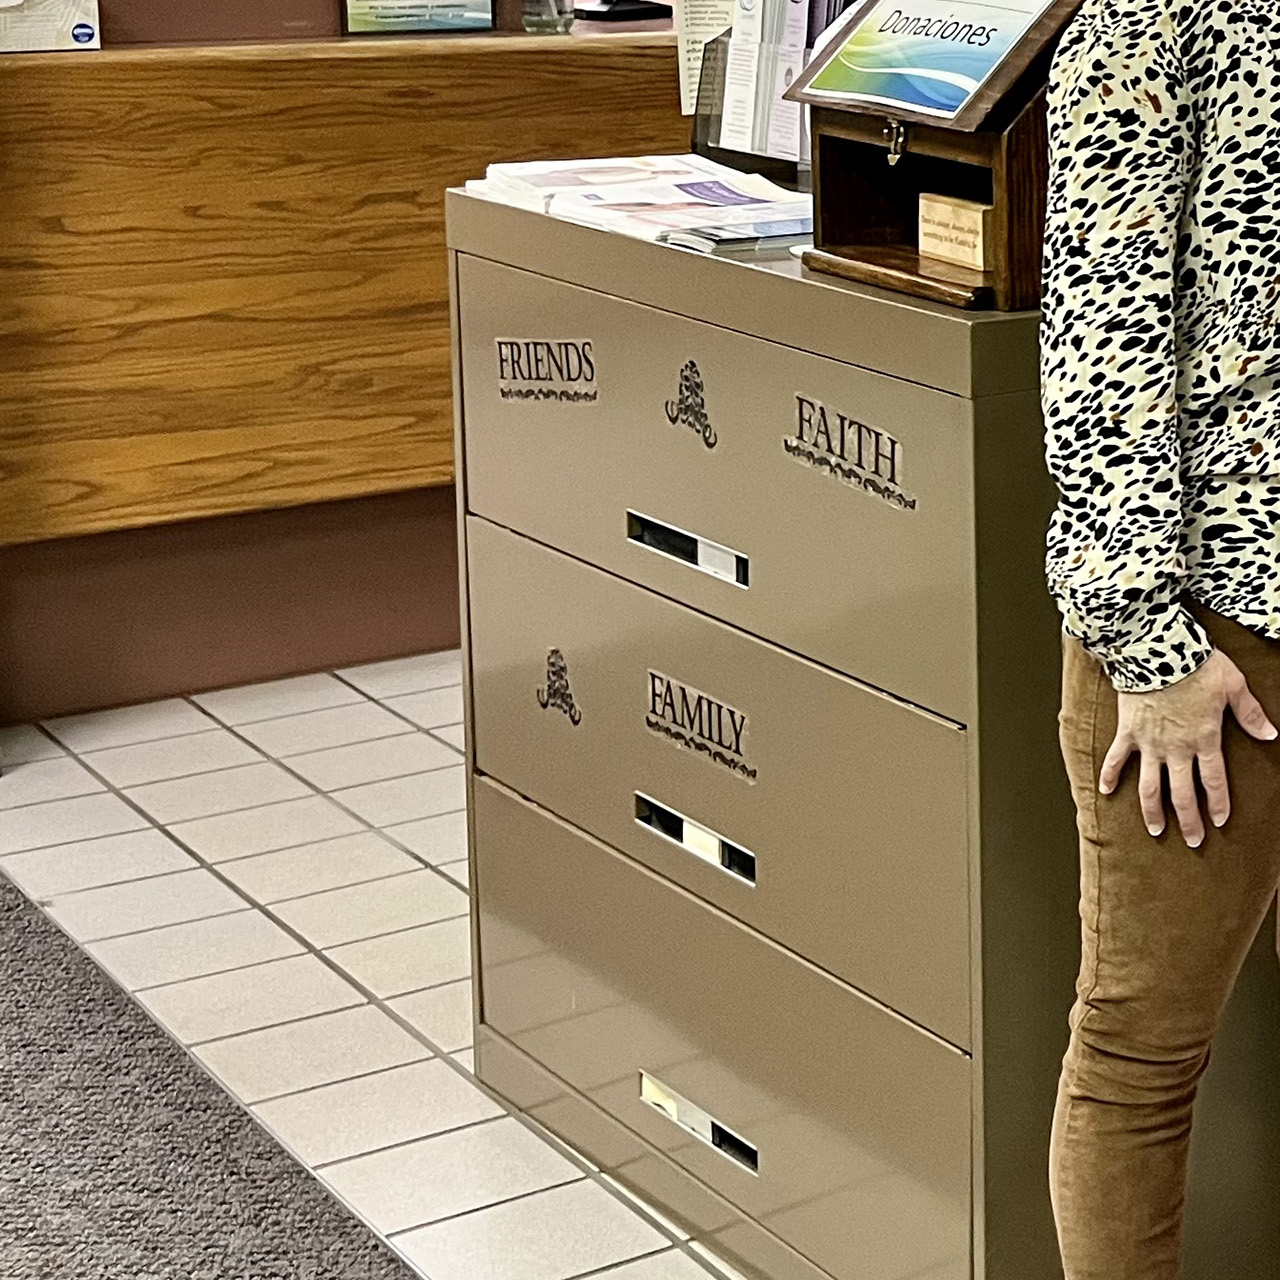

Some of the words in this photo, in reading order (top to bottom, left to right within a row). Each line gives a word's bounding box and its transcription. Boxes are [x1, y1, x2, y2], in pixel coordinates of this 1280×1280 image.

[879, 9, 998, 48] Donaciones
[496, 340, 596, 383] FRIENDS
[795, 396, 899, 486] FAITH
[650, 672, 748, 757] FAMILY
